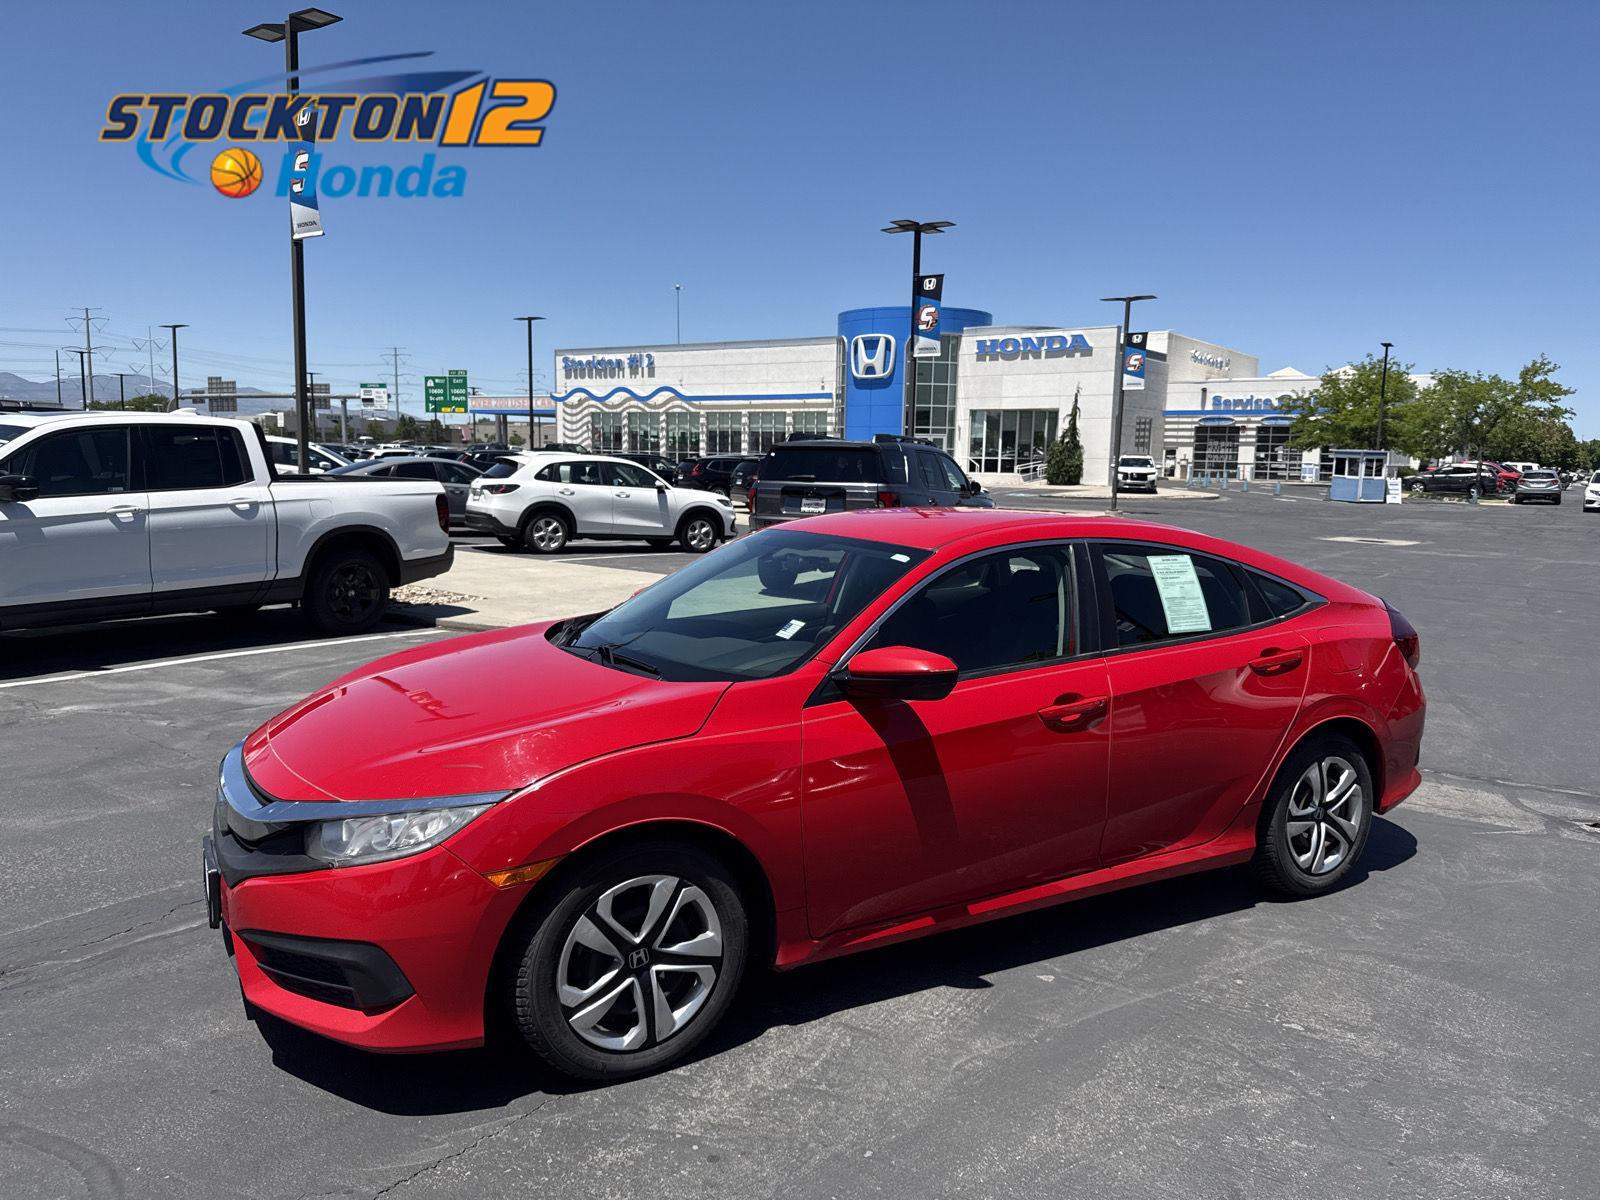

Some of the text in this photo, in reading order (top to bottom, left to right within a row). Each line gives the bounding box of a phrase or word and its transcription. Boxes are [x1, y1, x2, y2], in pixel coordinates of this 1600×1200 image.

[297, 220, 318, 229] HONDA
[975, 334, 1091, 355] HONDA
[562, 352, 656, 370] Stockton #12
[511, 399, 534, 408] USE
[1212, 394, 1273, 408] Service
